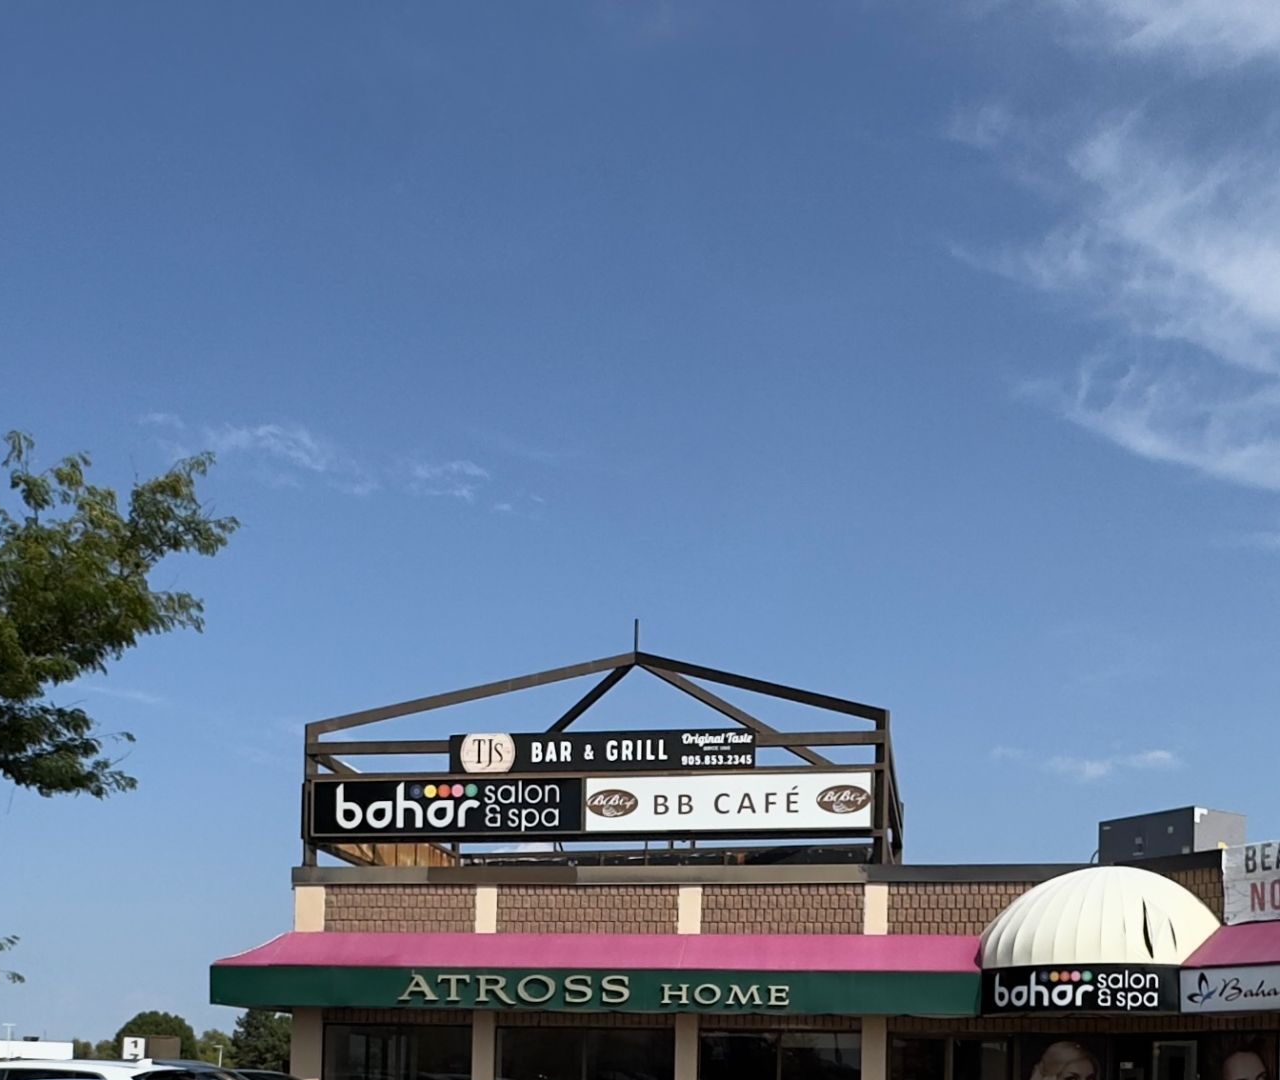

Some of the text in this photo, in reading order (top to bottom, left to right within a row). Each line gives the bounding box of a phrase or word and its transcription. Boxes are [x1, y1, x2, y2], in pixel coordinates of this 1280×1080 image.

[531, 741, 572, 762] BAR
[584, 745, 594, 760] &
[606, 739, 668, 761] GRILL
[681, 732, 753, 747] Original Taste
[681, 754, 752, 766] 905.853.2345
[484, 780, 560, 804] salon
[653, 785, 800, 815] BB CAFÉ
[335, 782, 481, 829] bahar
[485, 804, 559, 832] & spa
[399, 973, 790, 1006] ATROSS HOME
[994, 971, 1094, 1007] bahar
[1097, 970, 1159, 989] salon
[1097, 989, 1158, 1010] & spa
